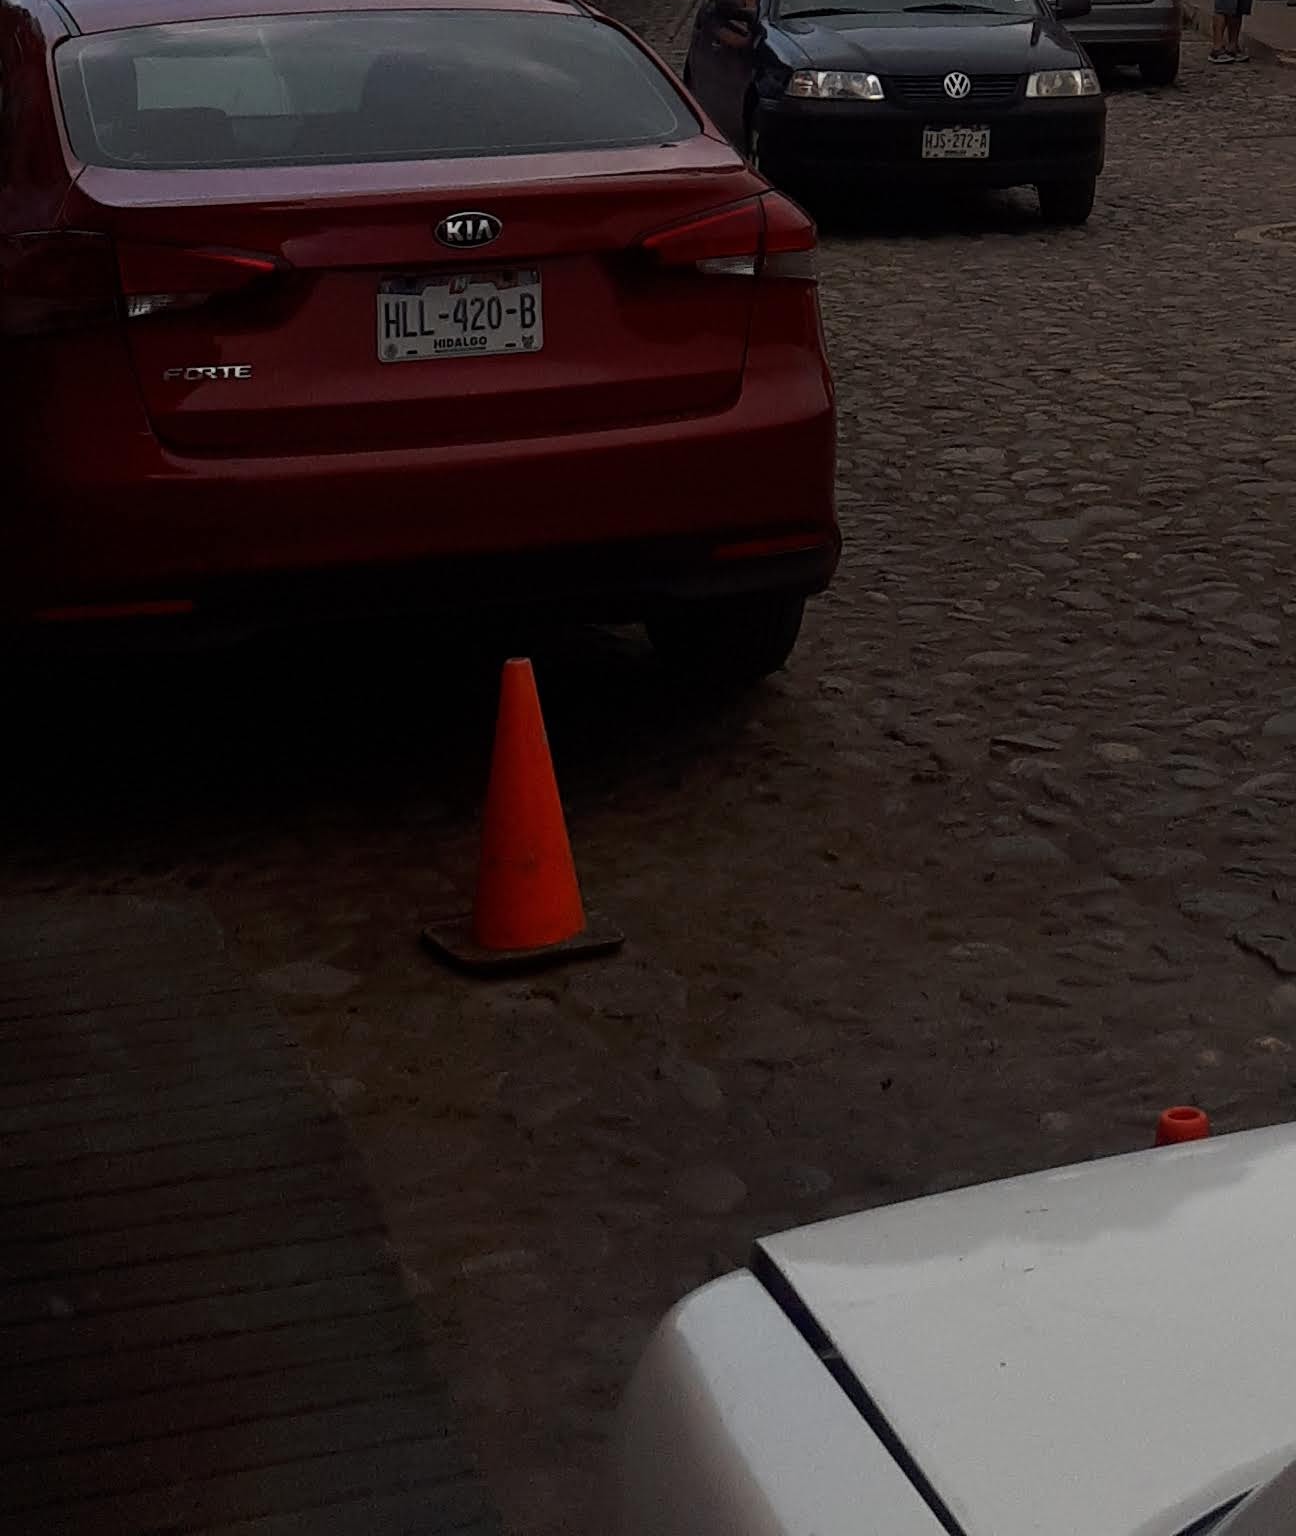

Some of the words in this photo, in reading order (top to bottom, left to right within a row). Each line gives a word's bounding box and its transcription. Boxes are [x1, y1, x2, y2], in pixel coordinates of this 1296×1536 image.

[925, 133, 987, 149] HJS-272-A
[446, 219, 494, 241] KIA
[384, 292, 536, 338] HLL-420-B
[433, 336, 487, 349] HIDALGO
[162, 364, 252, 382] FORTE
